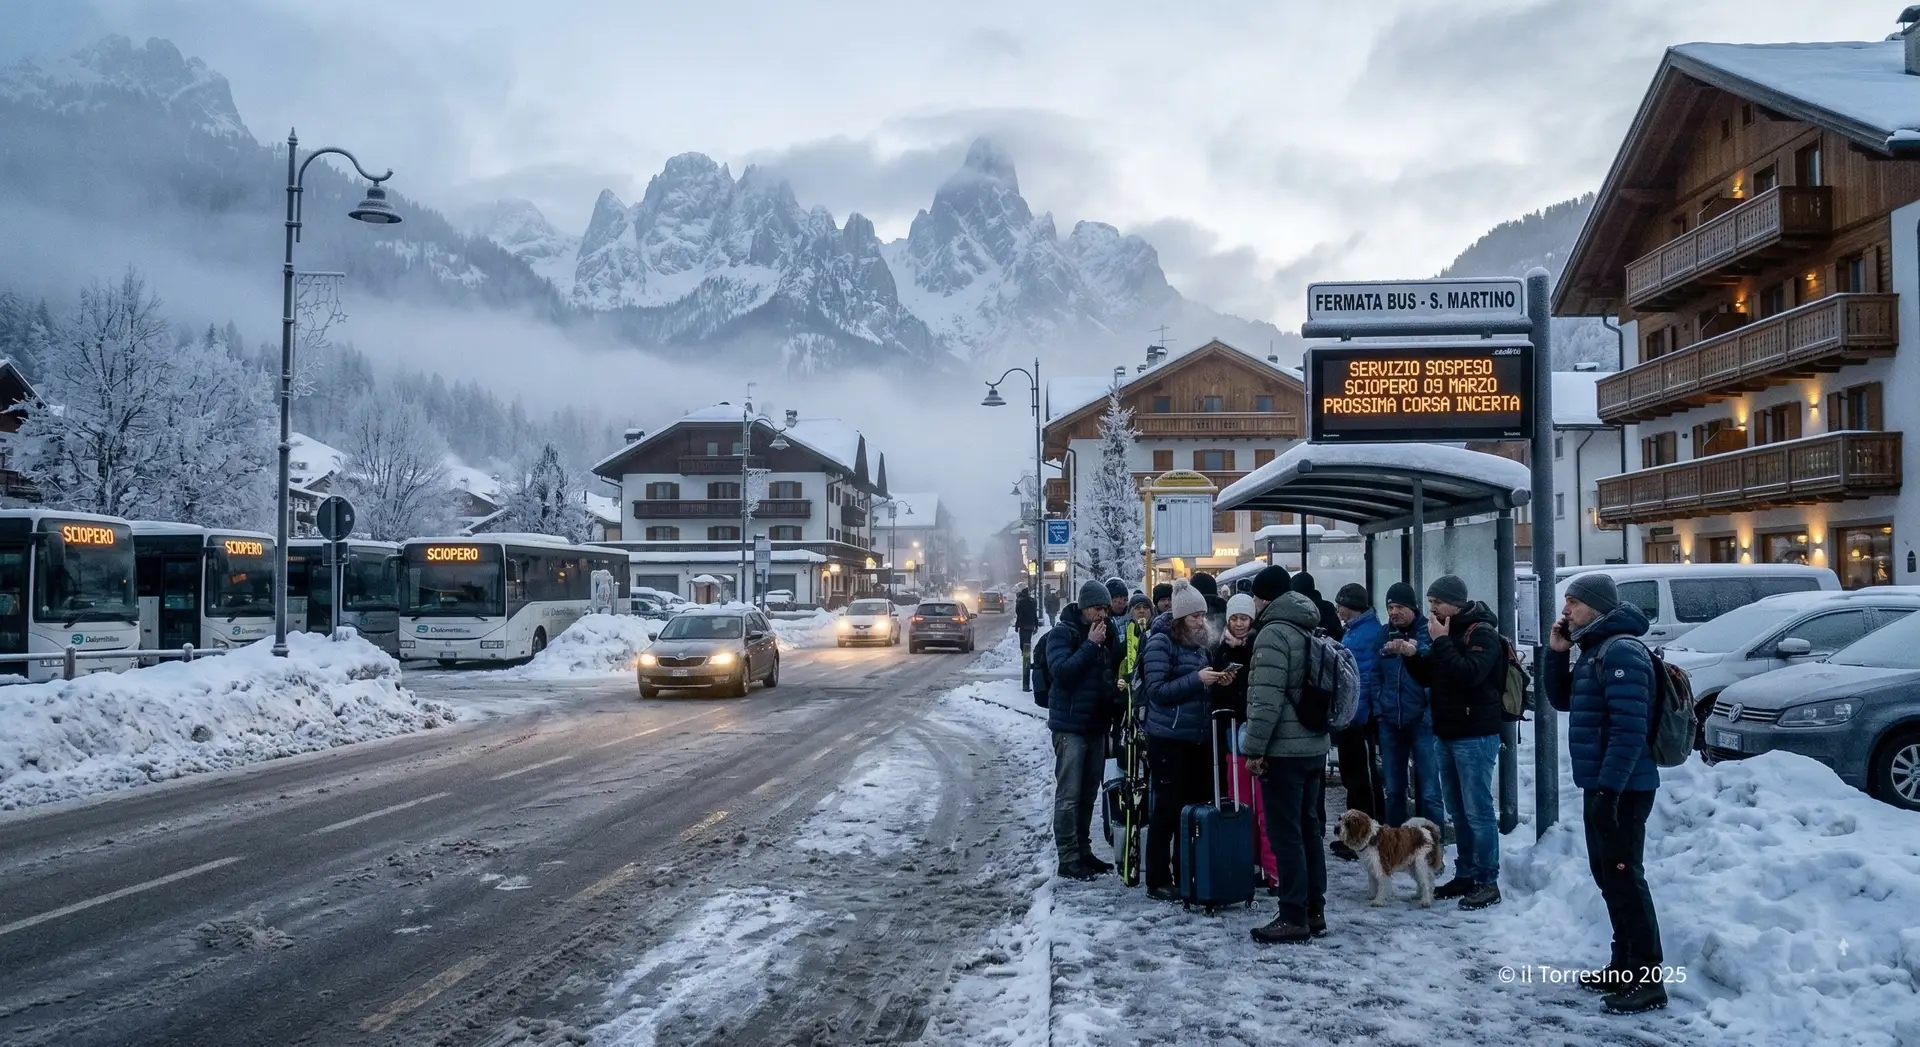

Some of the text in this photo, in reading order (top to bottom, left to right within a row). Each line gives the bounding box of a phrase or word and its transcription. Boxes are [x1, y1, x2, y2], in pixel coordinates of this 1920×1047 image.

[1315, 293, 1383, 311] FERMATA
[1387, 292, 1416, 310] BUS
[1430, 291, 1443, 309] S.
[1448, 290, 1515, 309] MARTINO
[1350, 359, 1493, 377] SERVIZIO SOSPESO
[1344, 377, 1497, 395] SCIOPERO 09 MARZO
[1323, 395, 1520, 414] PROSSIMA CORSA INCERTA
[63, 526, 115, 545] SCIOPERO
[224, 540, 263, 556] SCIOPERO
[426, 547, 479, 561] SCIOPERO
